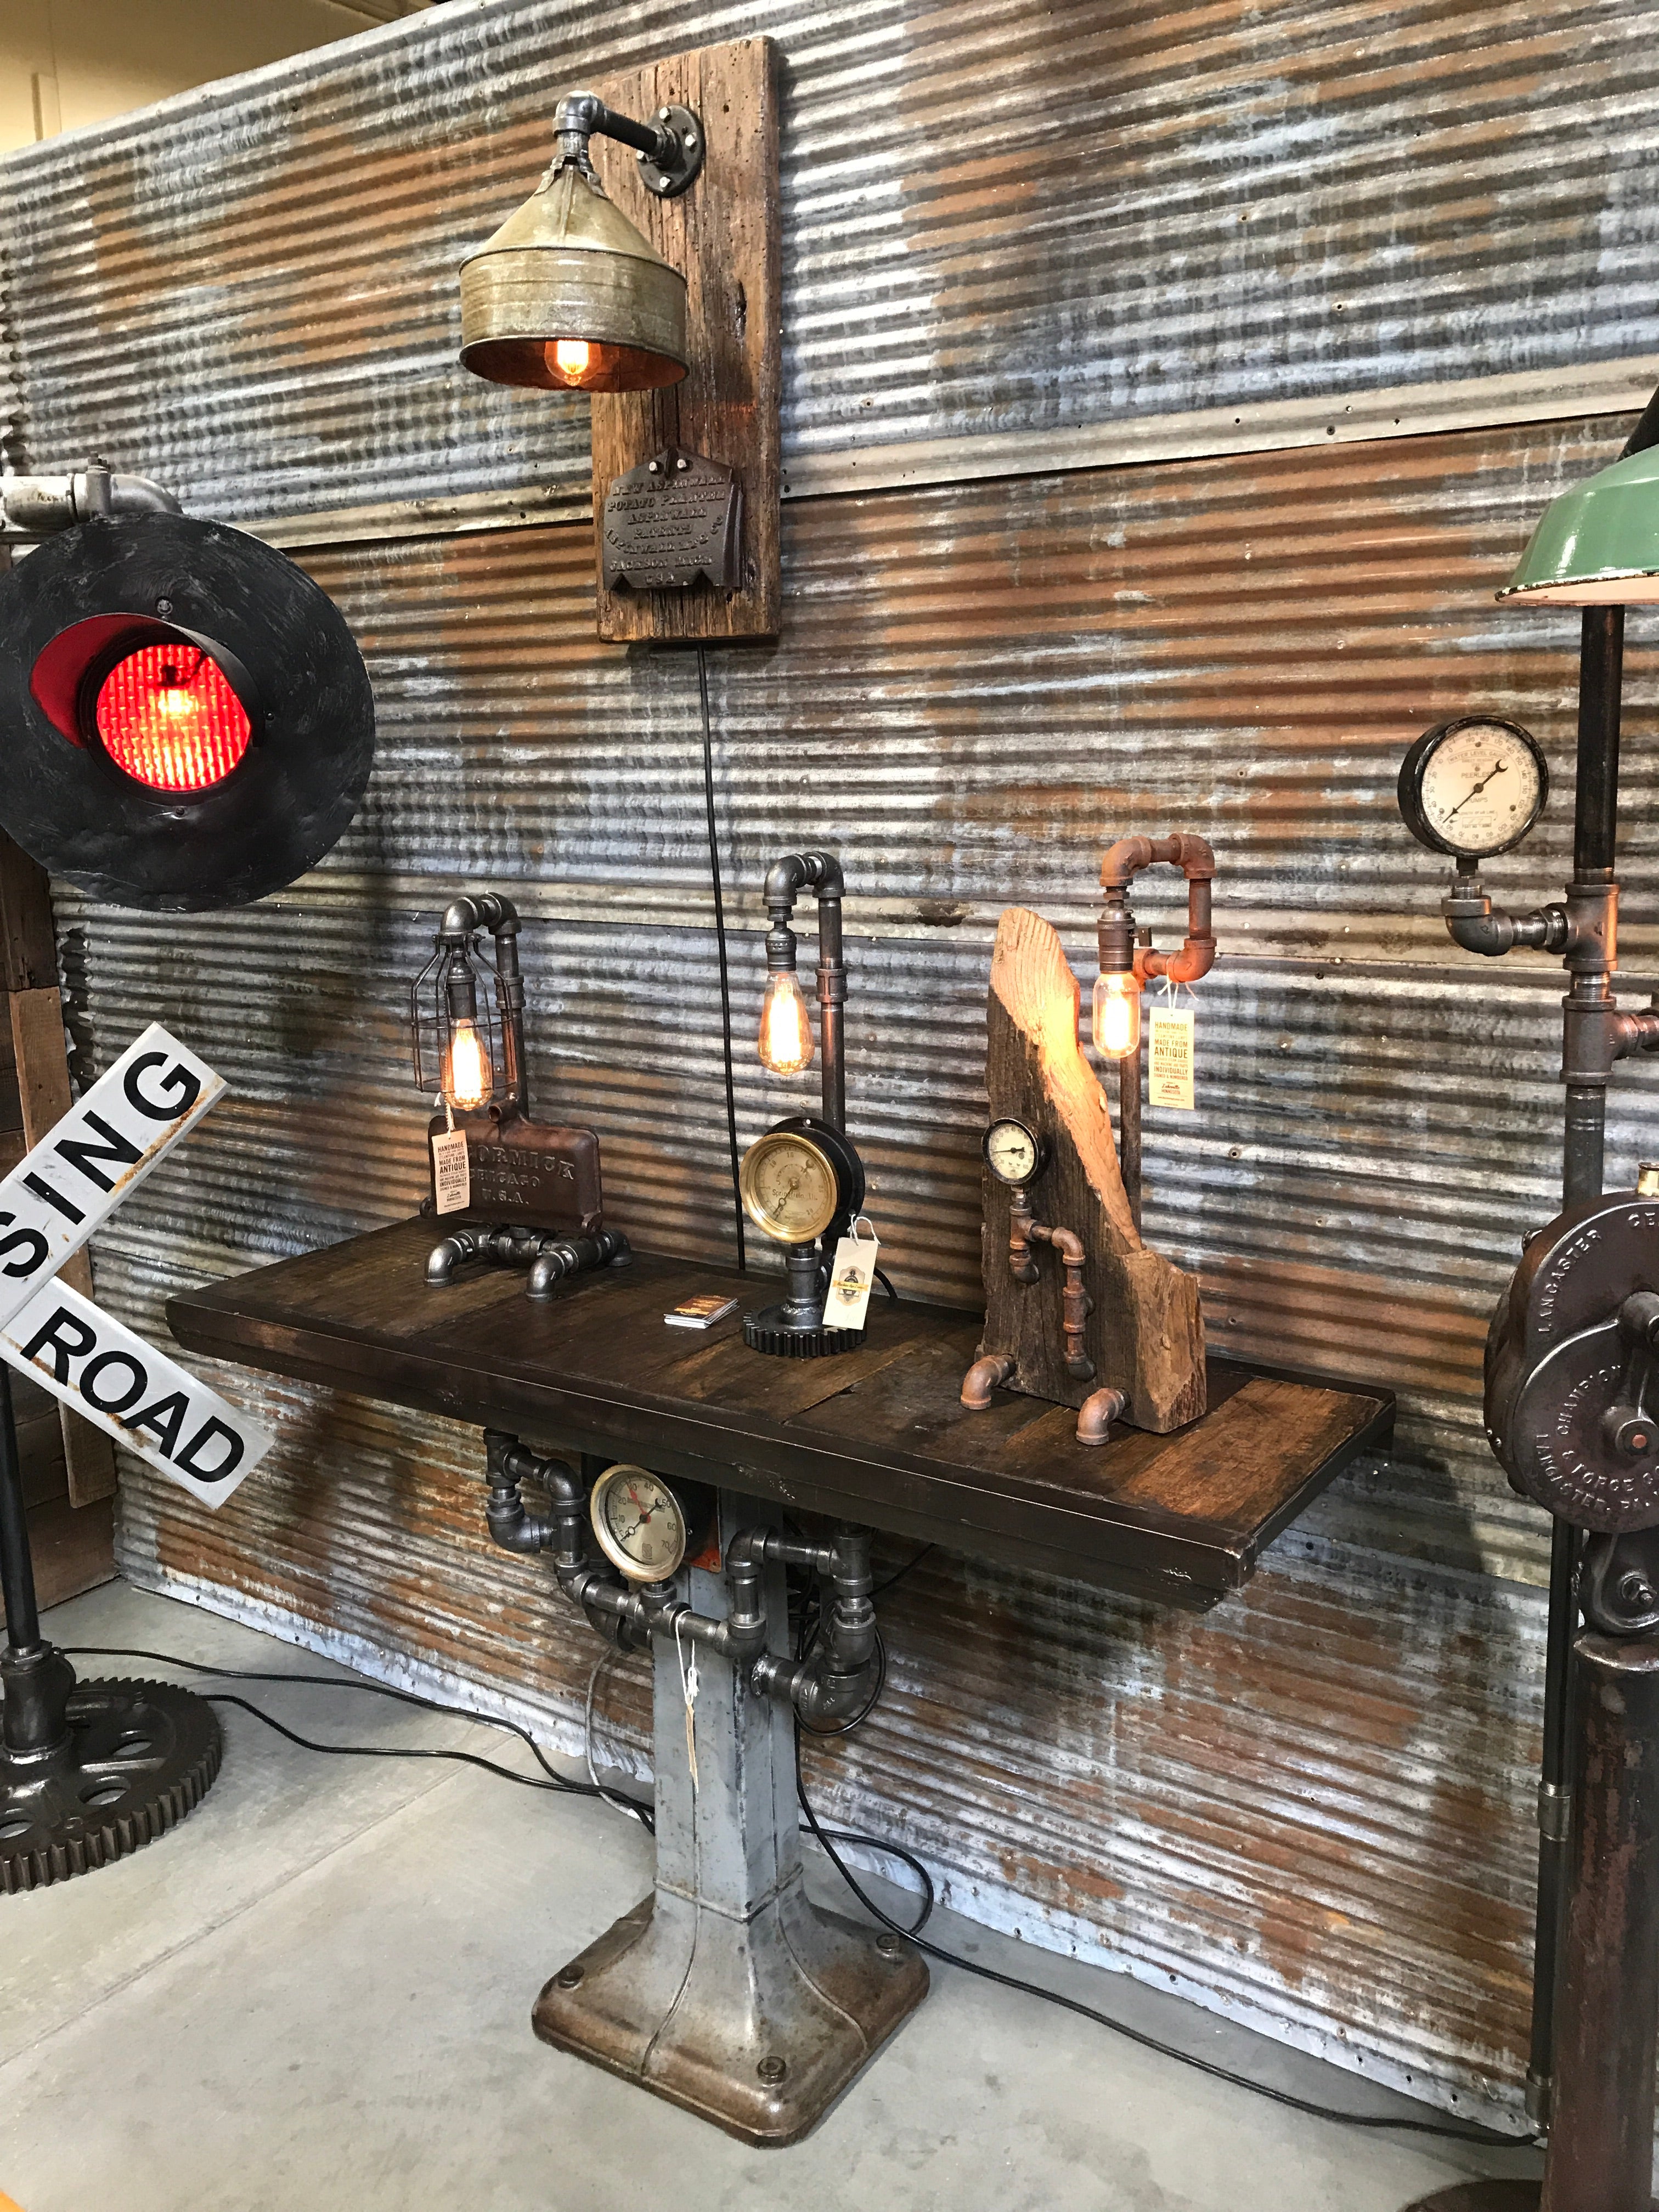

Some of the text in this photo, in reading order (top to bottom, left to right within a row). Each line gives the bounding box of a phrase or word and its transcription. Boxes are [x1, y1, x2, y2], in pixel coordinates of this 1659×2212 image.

[607, 497, 656, 512] POTATO
[1450, 752, 1468, 761] WATER
[1155, 1022, 1188, 1031] HANDMADE
[1154, 1046, 1188, 1058] ANTIQUE
[1154, 1066, 1188, 1075] INDIVIDUALLY
[438, 1141, 464, 1153] HANDMADE
[453, 1155, 465, 1163] FROM
[0, 1051, 201, 1278] SING
[439, 1161, 466, 1174] ANTIQUE
[482, 1188, 529, 1205] U.S.A.
[772, 1189, 805, 1198] Sprinfield
[1538, 1212, 1659, 1332] LANCASTER GE
[20, 1306, 245, 1483] ROAD
[1571, 1463, 1634, 1492] FORGE
[644, 1483, 654, 1492] 40
[618, 1495, 627, 1505] 20
[662, 1499, 672, 1508] 50
[619, 1514, 625, 1523] 10
[667, 1522, 676, 1531] 60
[661, 1540, 670, 1549] 70
